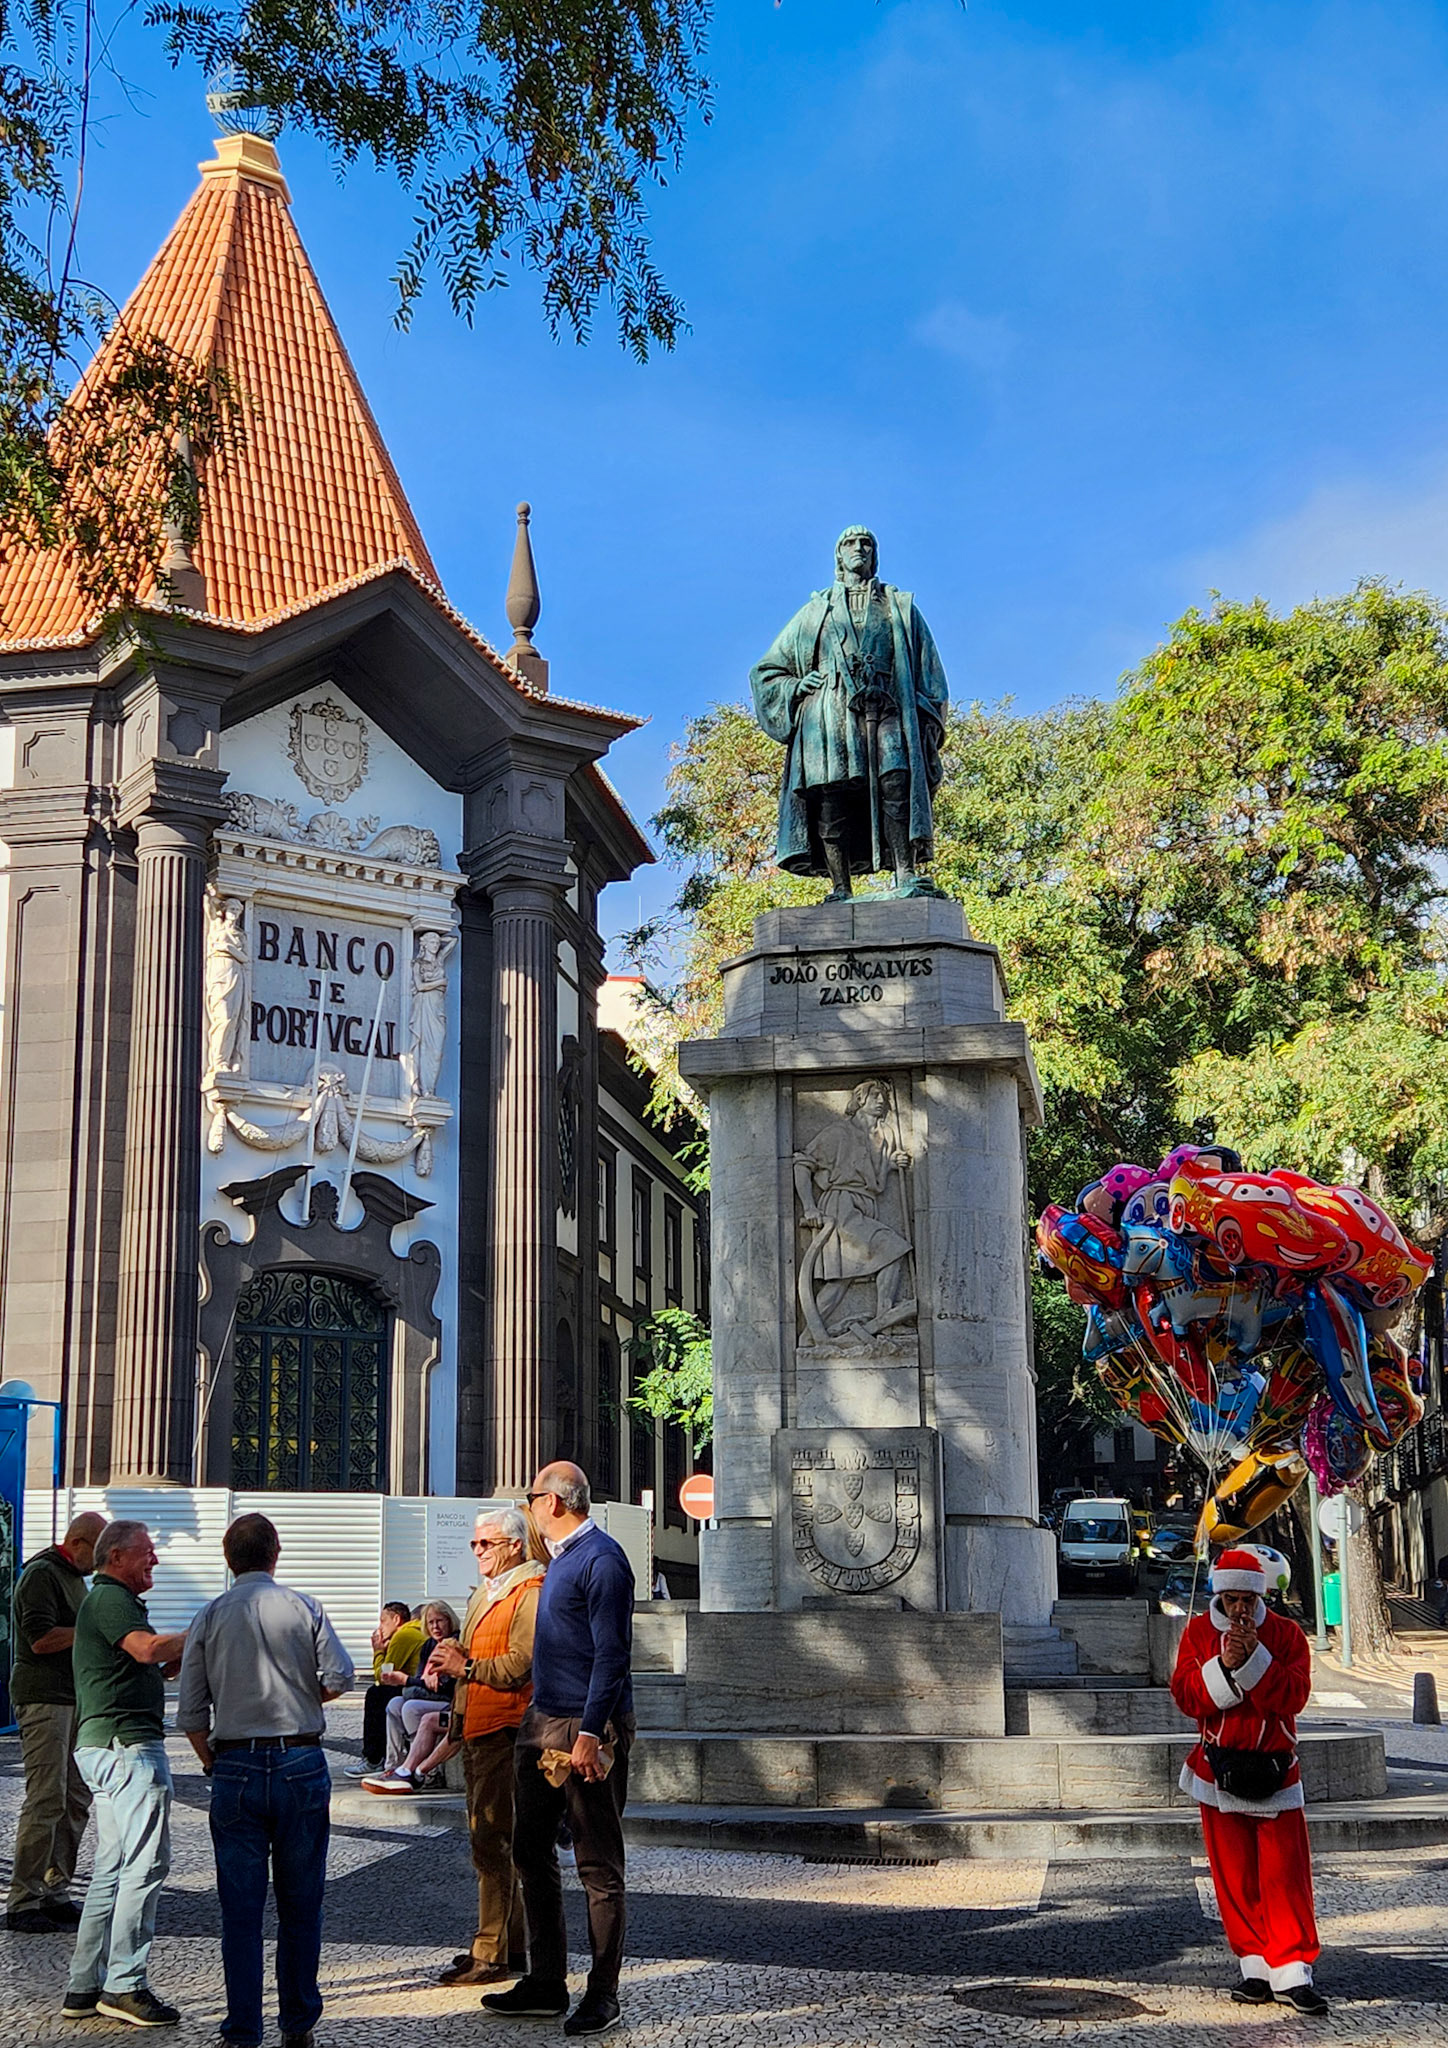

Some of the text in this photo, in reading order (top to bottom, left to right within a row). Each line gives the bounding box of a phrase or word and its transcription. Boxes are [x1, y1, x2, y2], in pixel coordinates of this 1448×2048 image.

[258, 921, 395, 981] BANCO
[769, 960, 818, 985] JOÃO
[308, 979, 346, 1004] DE
[819, 984, 884, 1006] ZARCO
[250, 1001, 400, 1062] PORTVGAL
[436, 1520, 470, 1528] PORTUGAL
